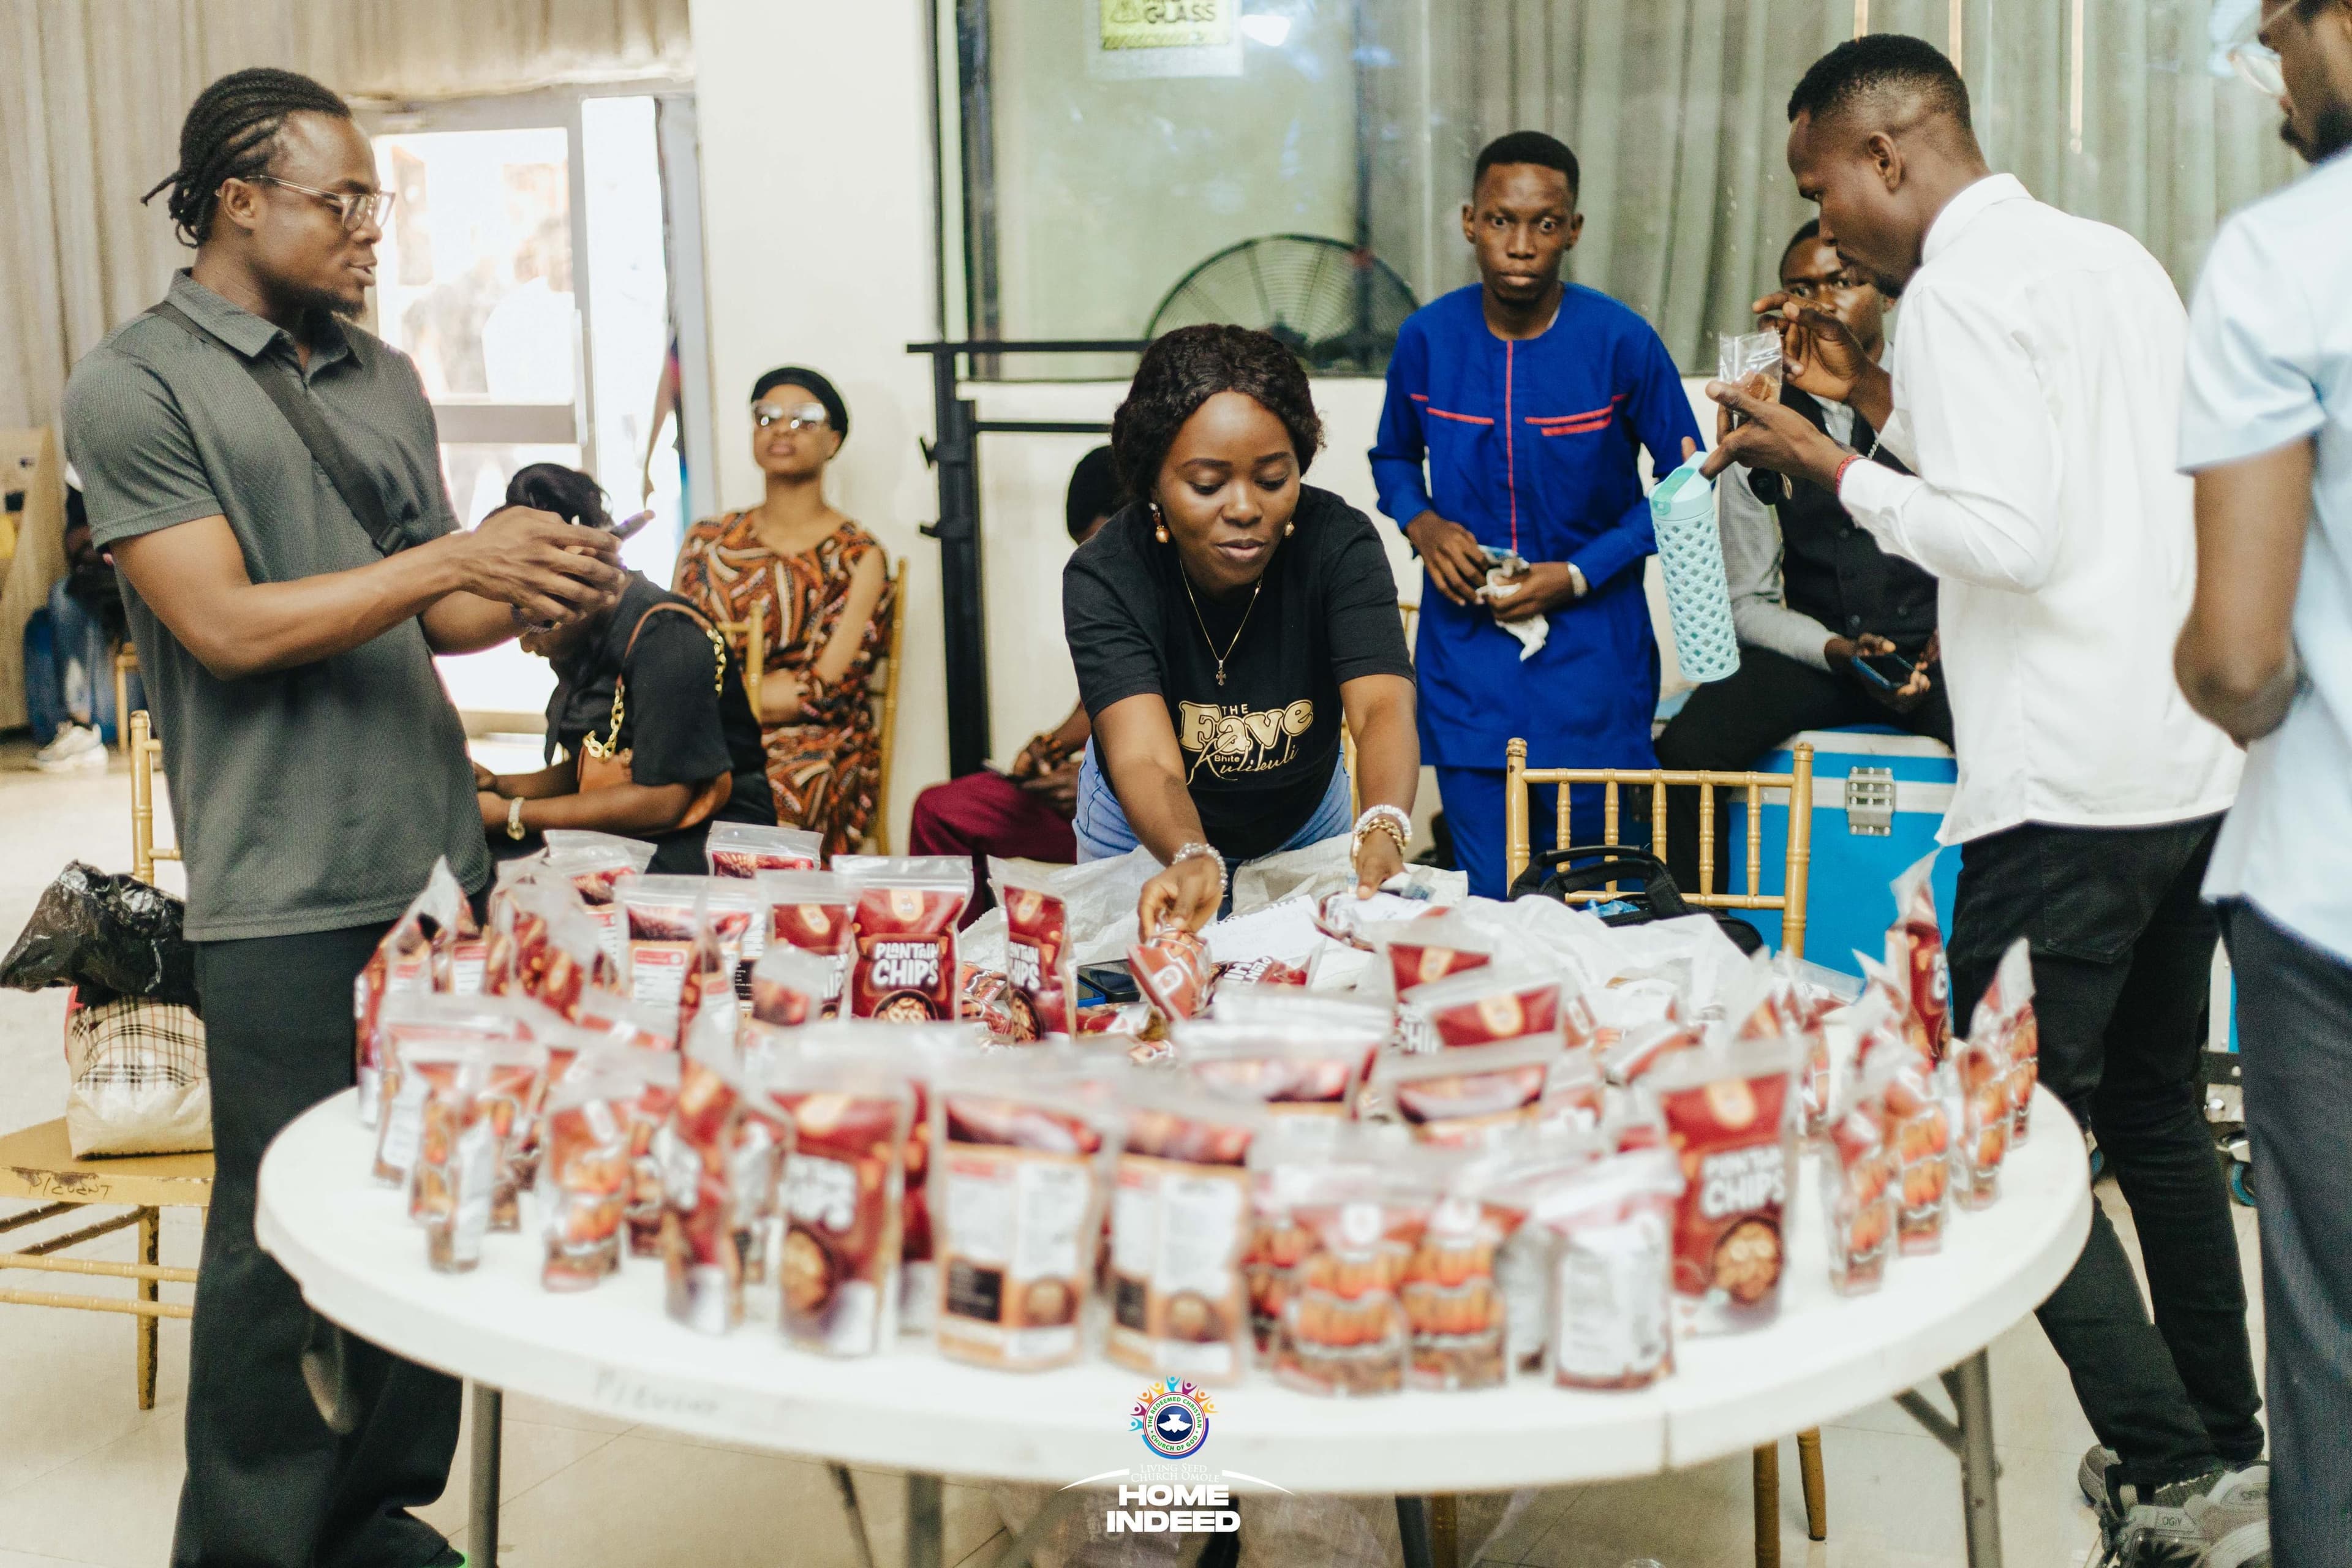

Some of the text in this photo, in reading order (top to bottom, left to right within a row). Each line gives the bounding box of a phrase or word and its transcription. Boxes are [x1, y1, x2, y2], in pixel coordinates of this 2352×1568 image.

[1144, 3, 1216, 24] GLASS
[1221, 704, 1248, 714] THE
[1179, 699, 1314, 753] Fave
[872, 959, 939, 987] CHIPS
[1009, 957, 1041, 990] HIPS
